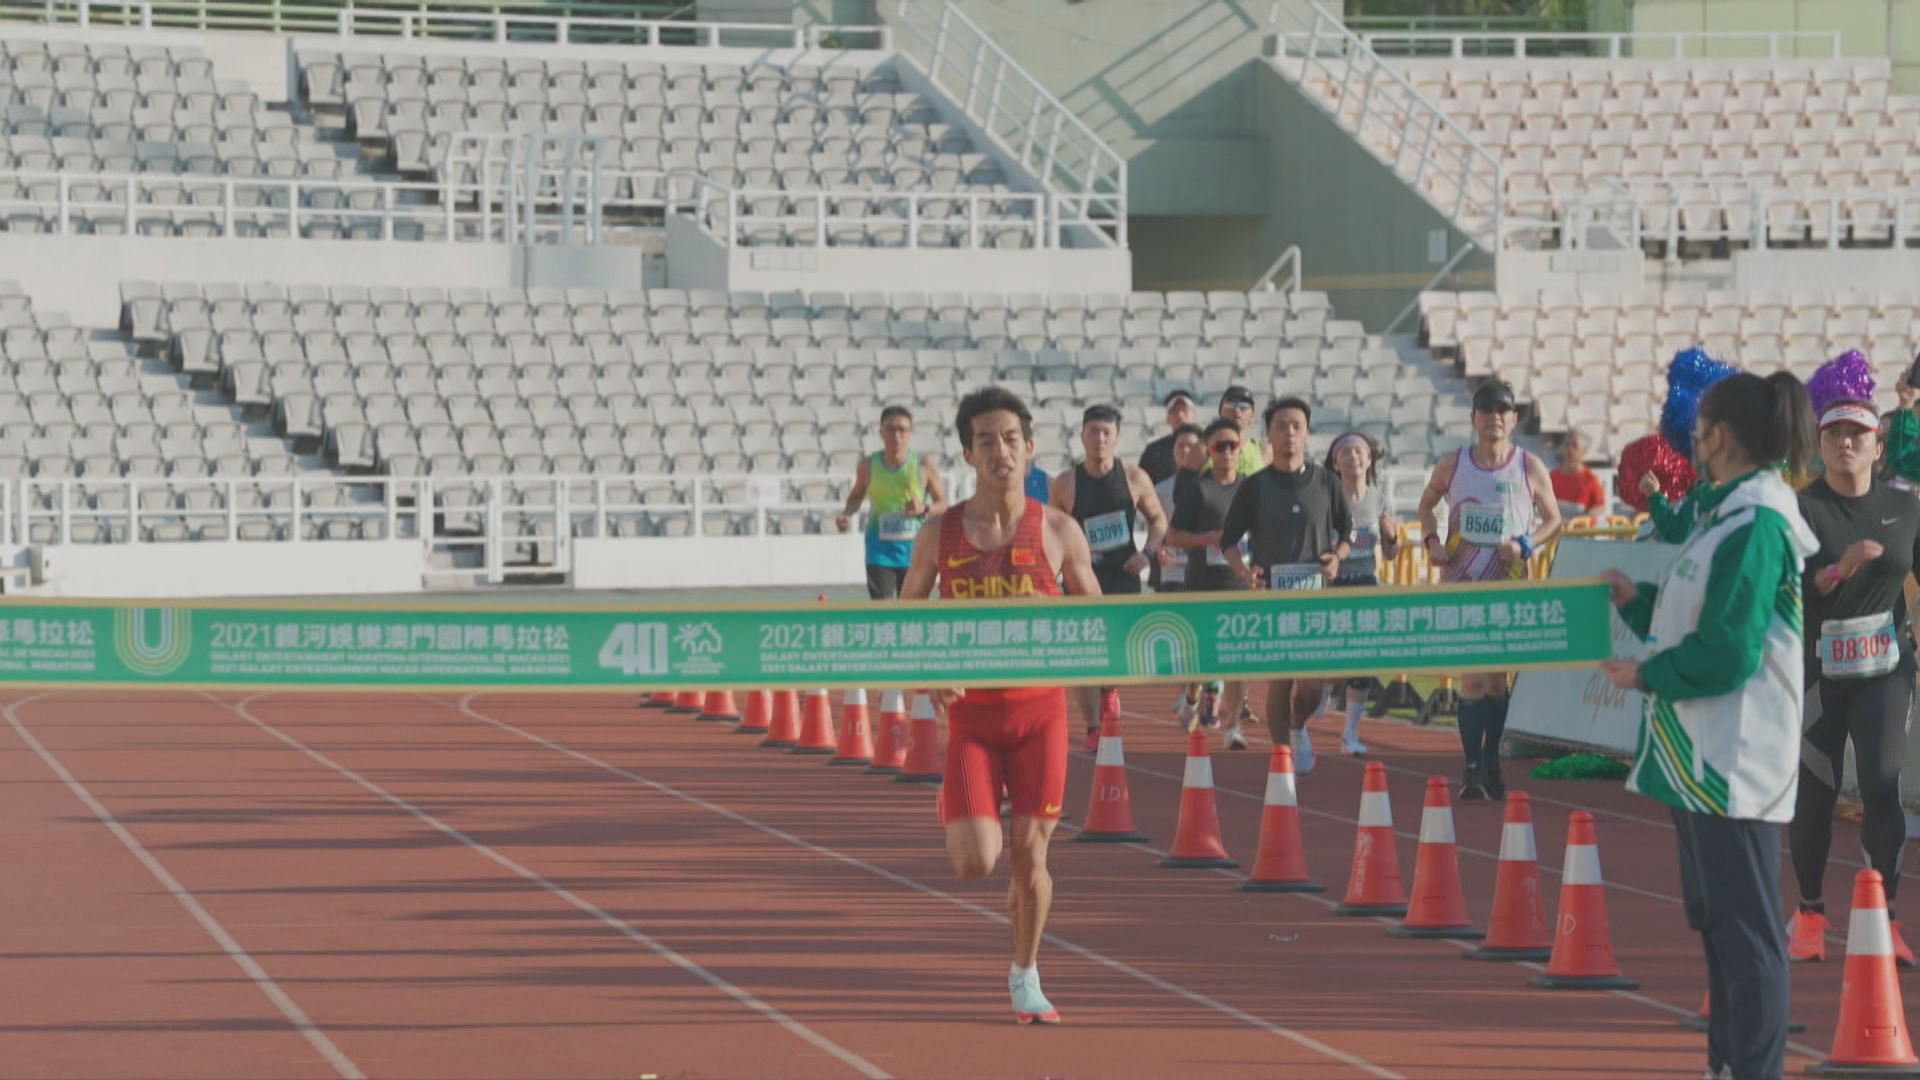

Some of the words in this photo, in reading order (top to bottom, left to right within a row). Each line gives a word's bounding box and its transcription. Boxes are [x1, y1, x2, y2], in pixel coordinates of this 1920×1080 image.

[951, 573, 1034, 598] CHINA
[598, 622, 669, 674] 40
[1831, 632, 1891, 662] B8309
